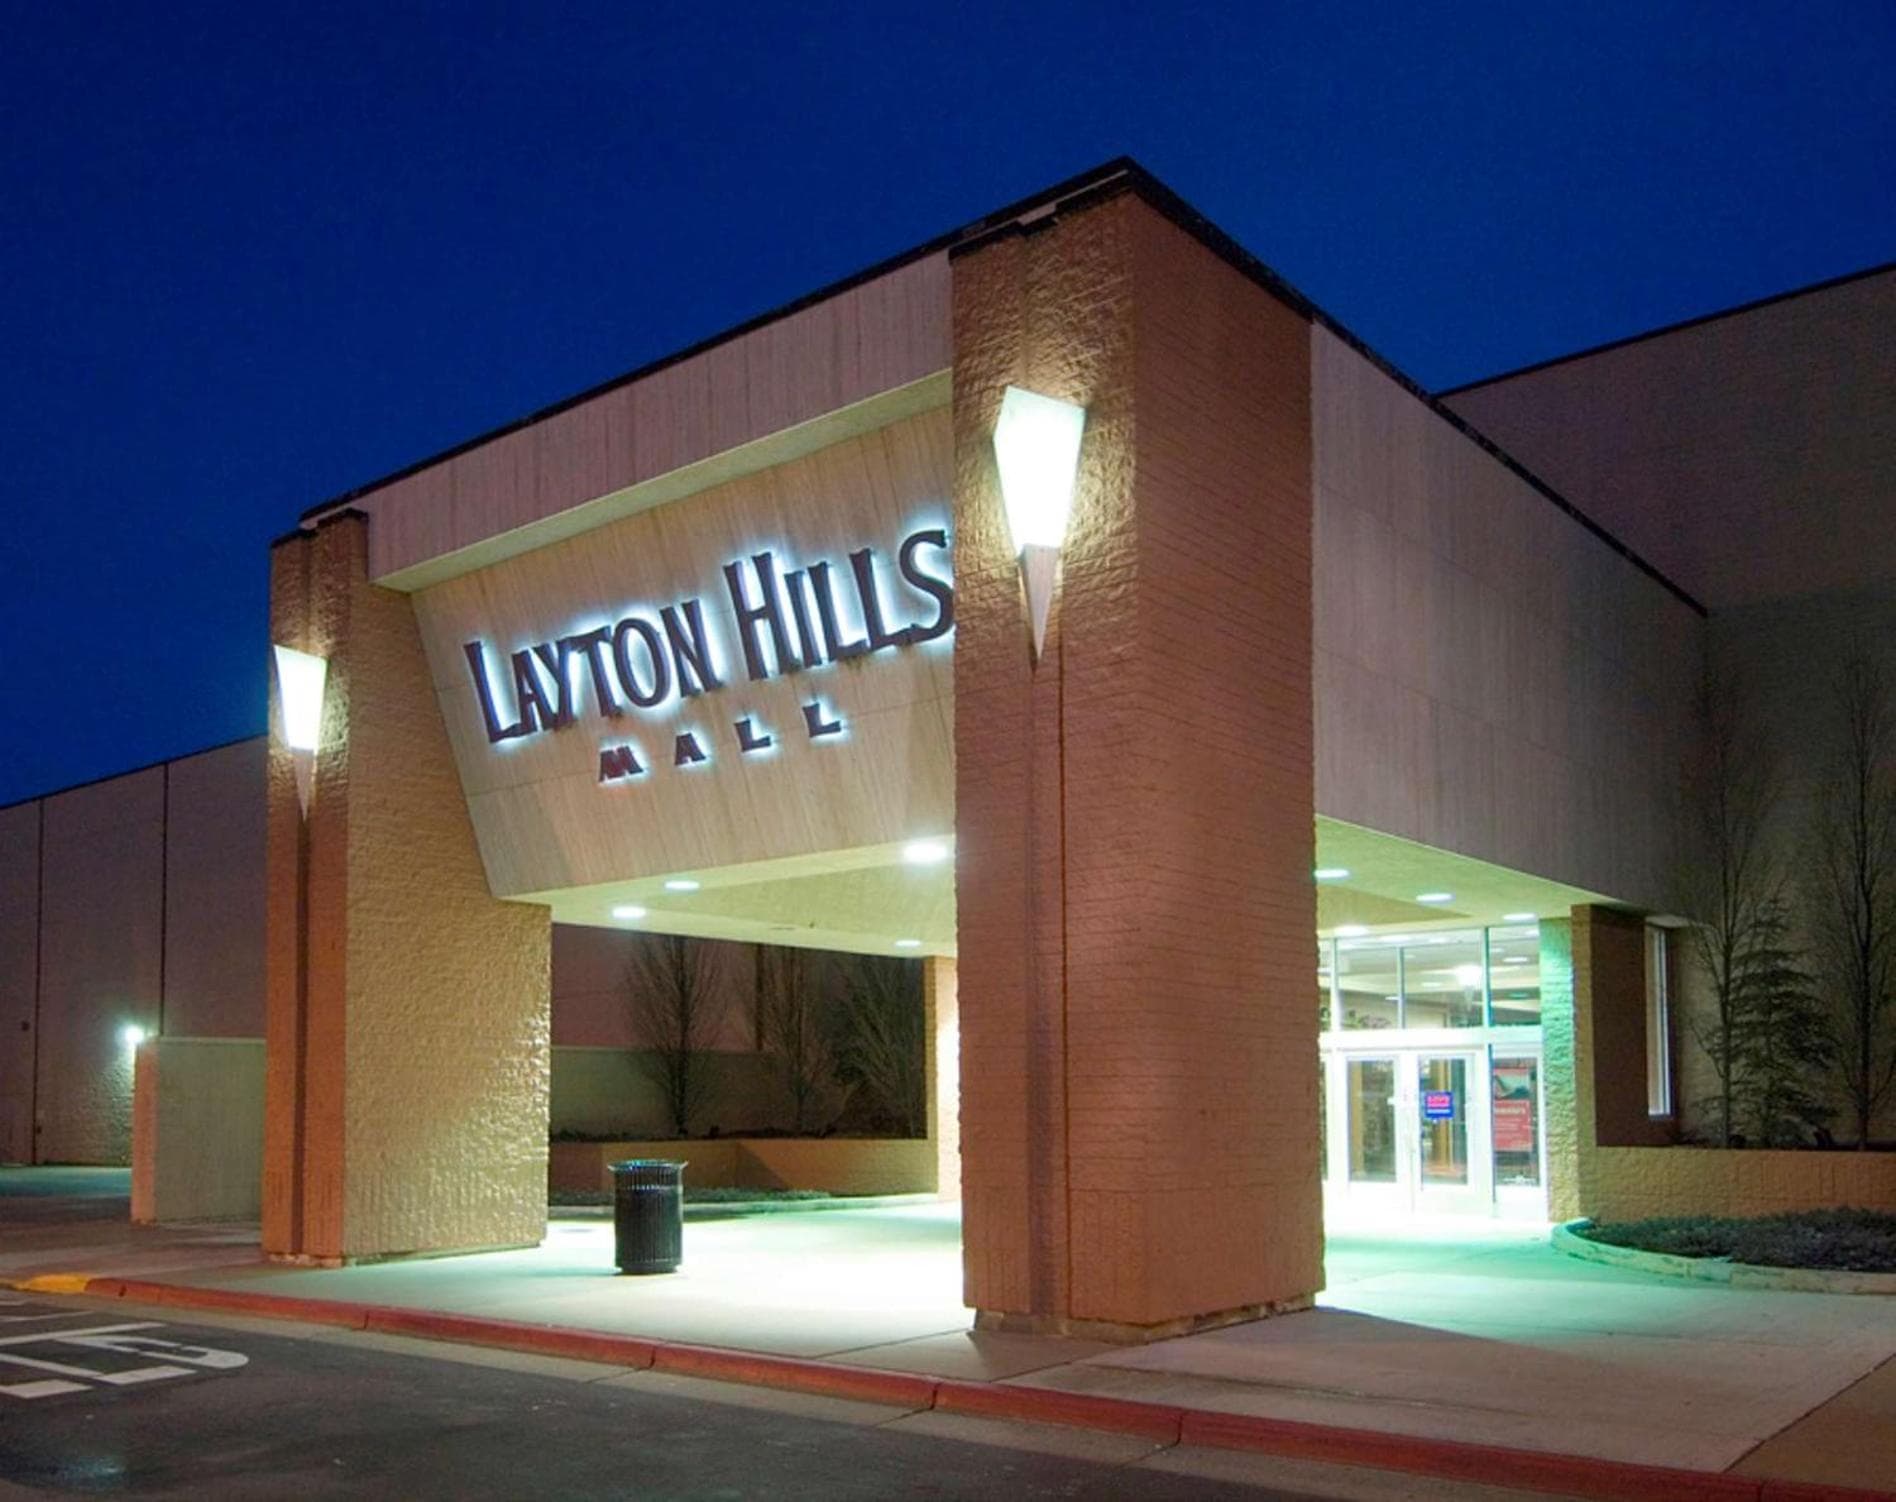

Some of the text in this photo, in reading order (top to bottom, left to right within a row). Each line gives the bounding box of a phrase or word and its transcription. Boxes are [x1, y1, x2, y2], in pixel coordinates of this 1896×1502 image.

[464, 530, 954, 743] LAYTON HILLS
[598, 703, 841, 782] MALL
